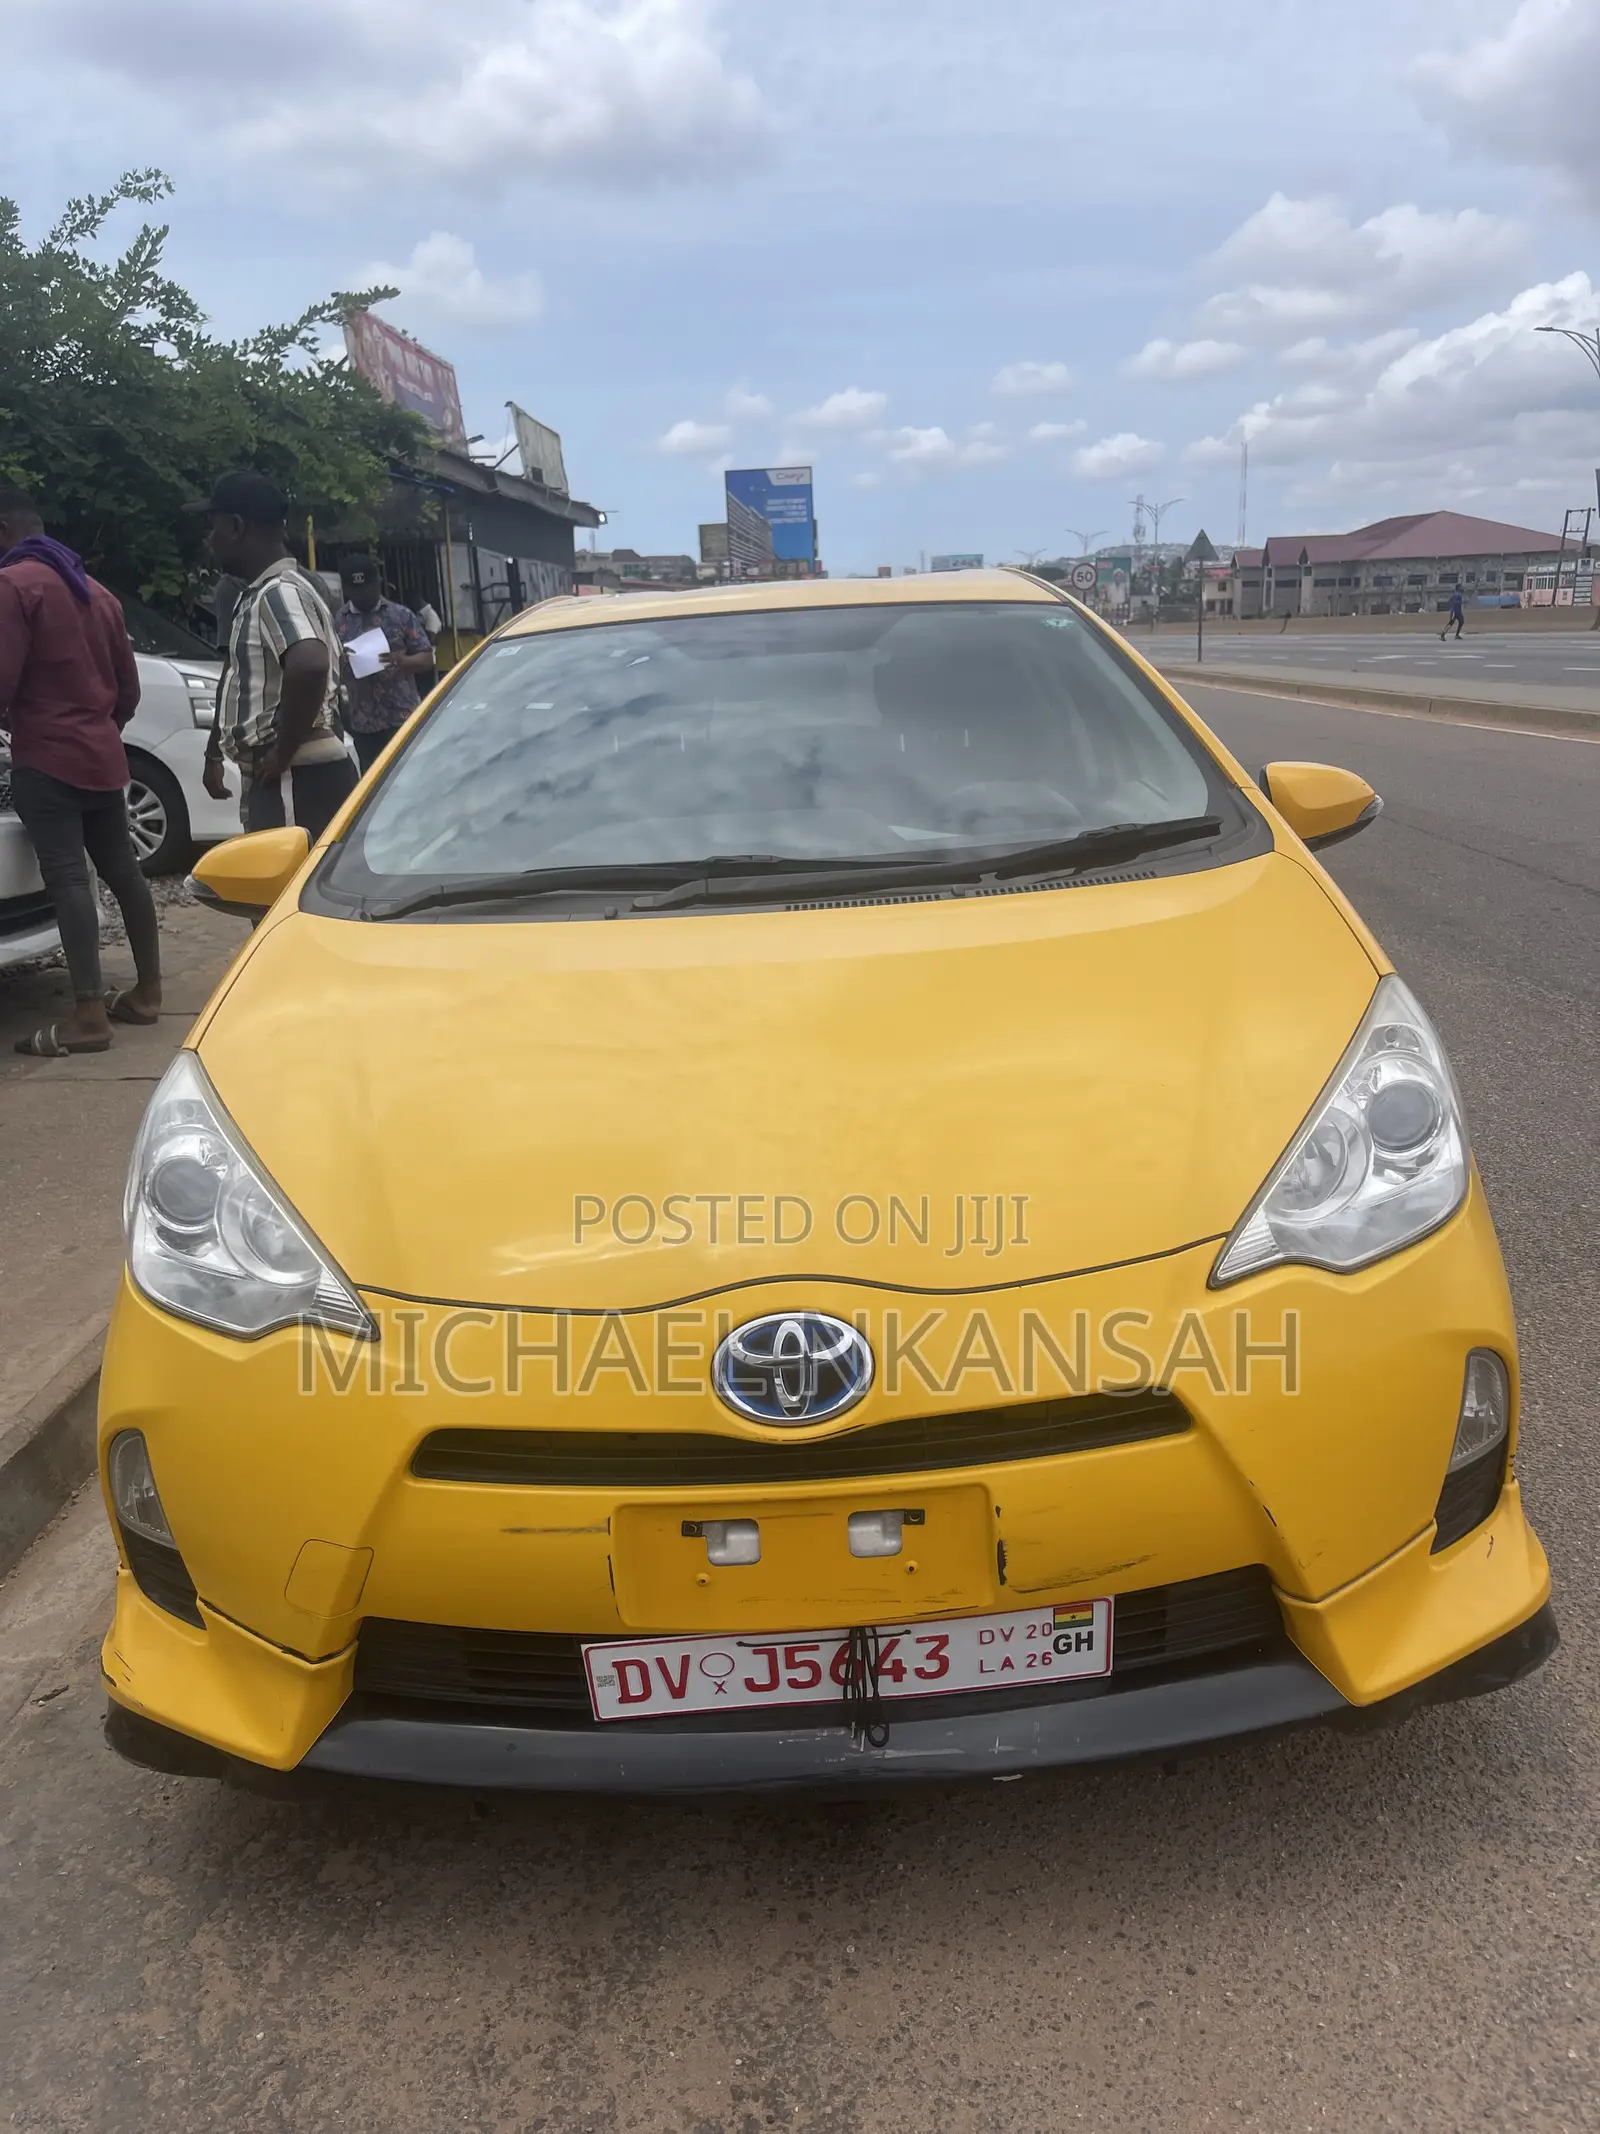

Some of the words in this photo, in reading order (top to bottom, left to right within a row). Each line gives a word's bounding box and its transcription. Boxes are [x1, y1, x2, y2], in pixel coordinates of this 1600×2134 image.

[1076, 571, 1093, 582] 50
[979, 1625, 1015, 1645] DV
[1026, 1622, 1053, 1639] 20
[1053, 1630, 1093, 1655] GH
[611, 1654, 691, 1704] DV
[744, 1635, 950, 1693] J5643
[980, 1655, 1015, 1673] LA
[1026, 1651, 1053, 1668] 26
